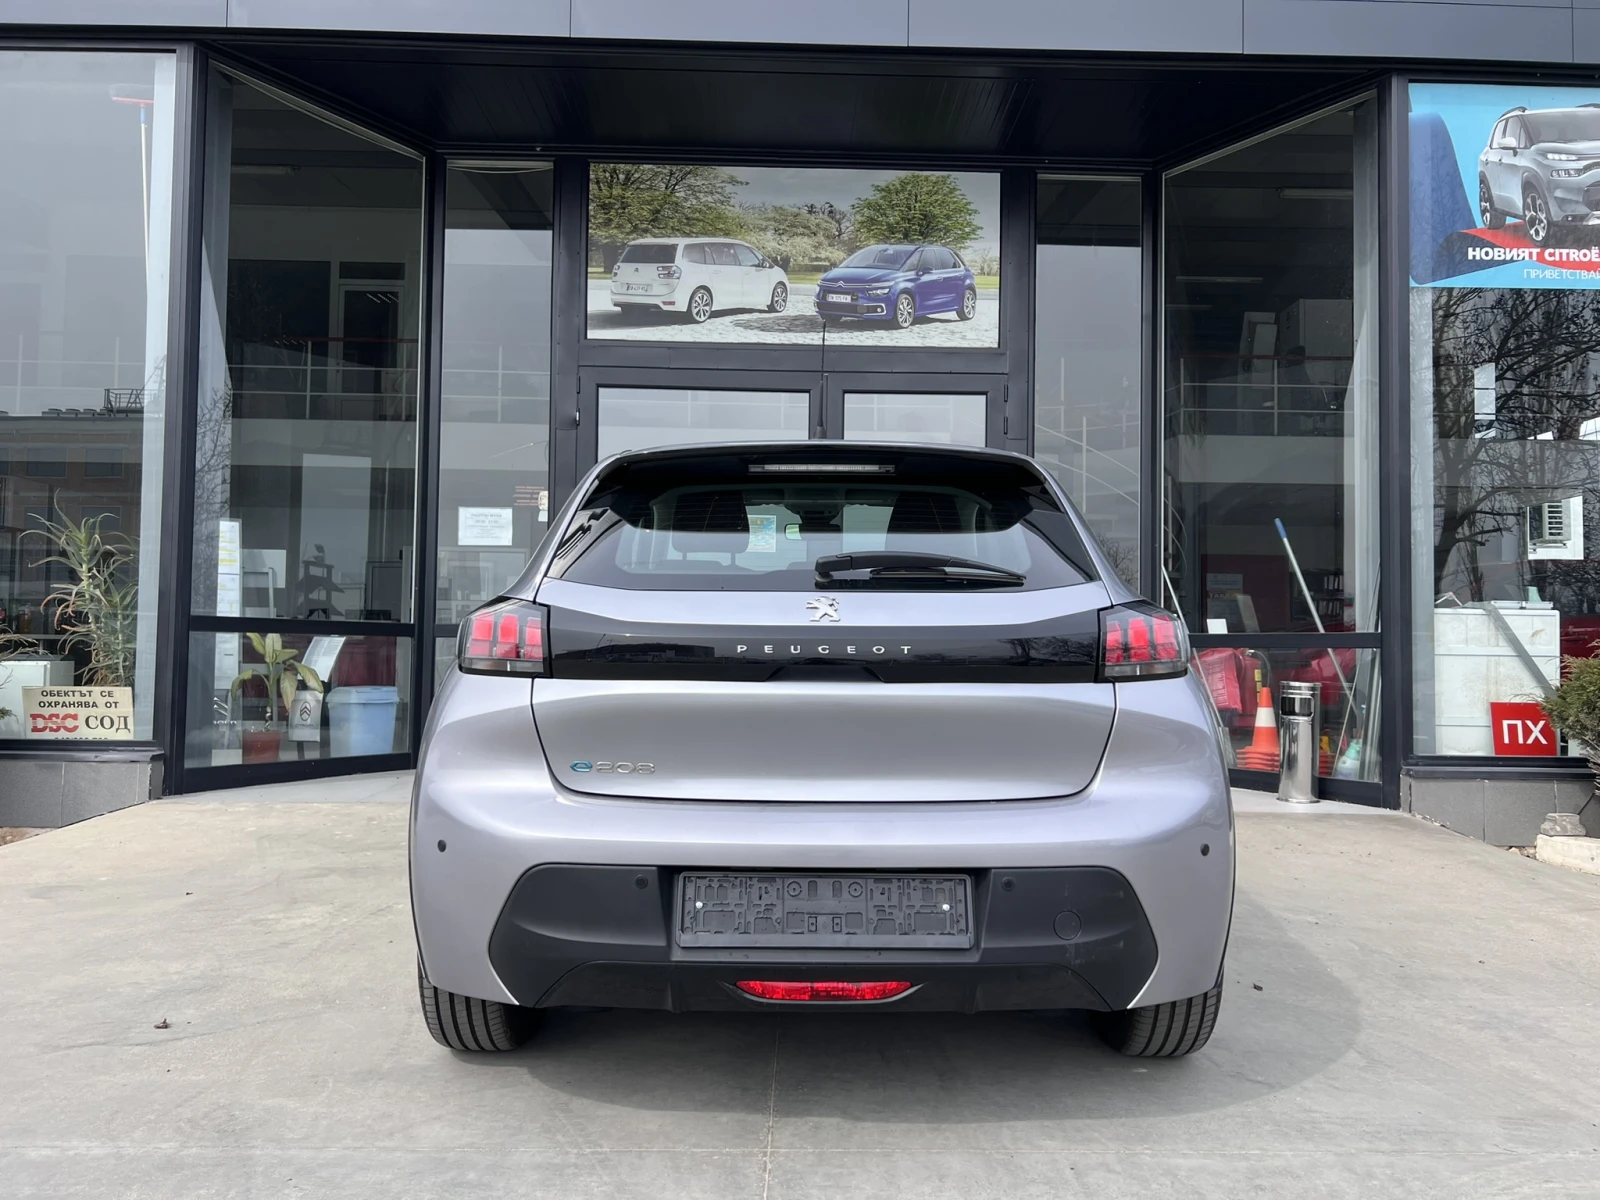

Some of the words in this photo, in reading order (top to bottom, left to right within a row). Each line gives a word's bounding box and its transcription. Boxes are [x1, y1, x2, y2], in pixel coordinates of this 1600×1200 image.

[1467, 247, 1540, 261] НОВИЯТ
[737, 645, 912, 655] PEUGEOT
[41, 690, 93, 698] ОБЕКТЪТ
[100, 690, 114, 698] СЕ
[38, 701, 98, 709] ОХРАНЯВА
[105, 701, 119, 709] ОТ
[30, 713, 79, 733] DSC
[85, 715, 131, 733] СОД
[1502, 720, 1548, 744] ПХ
